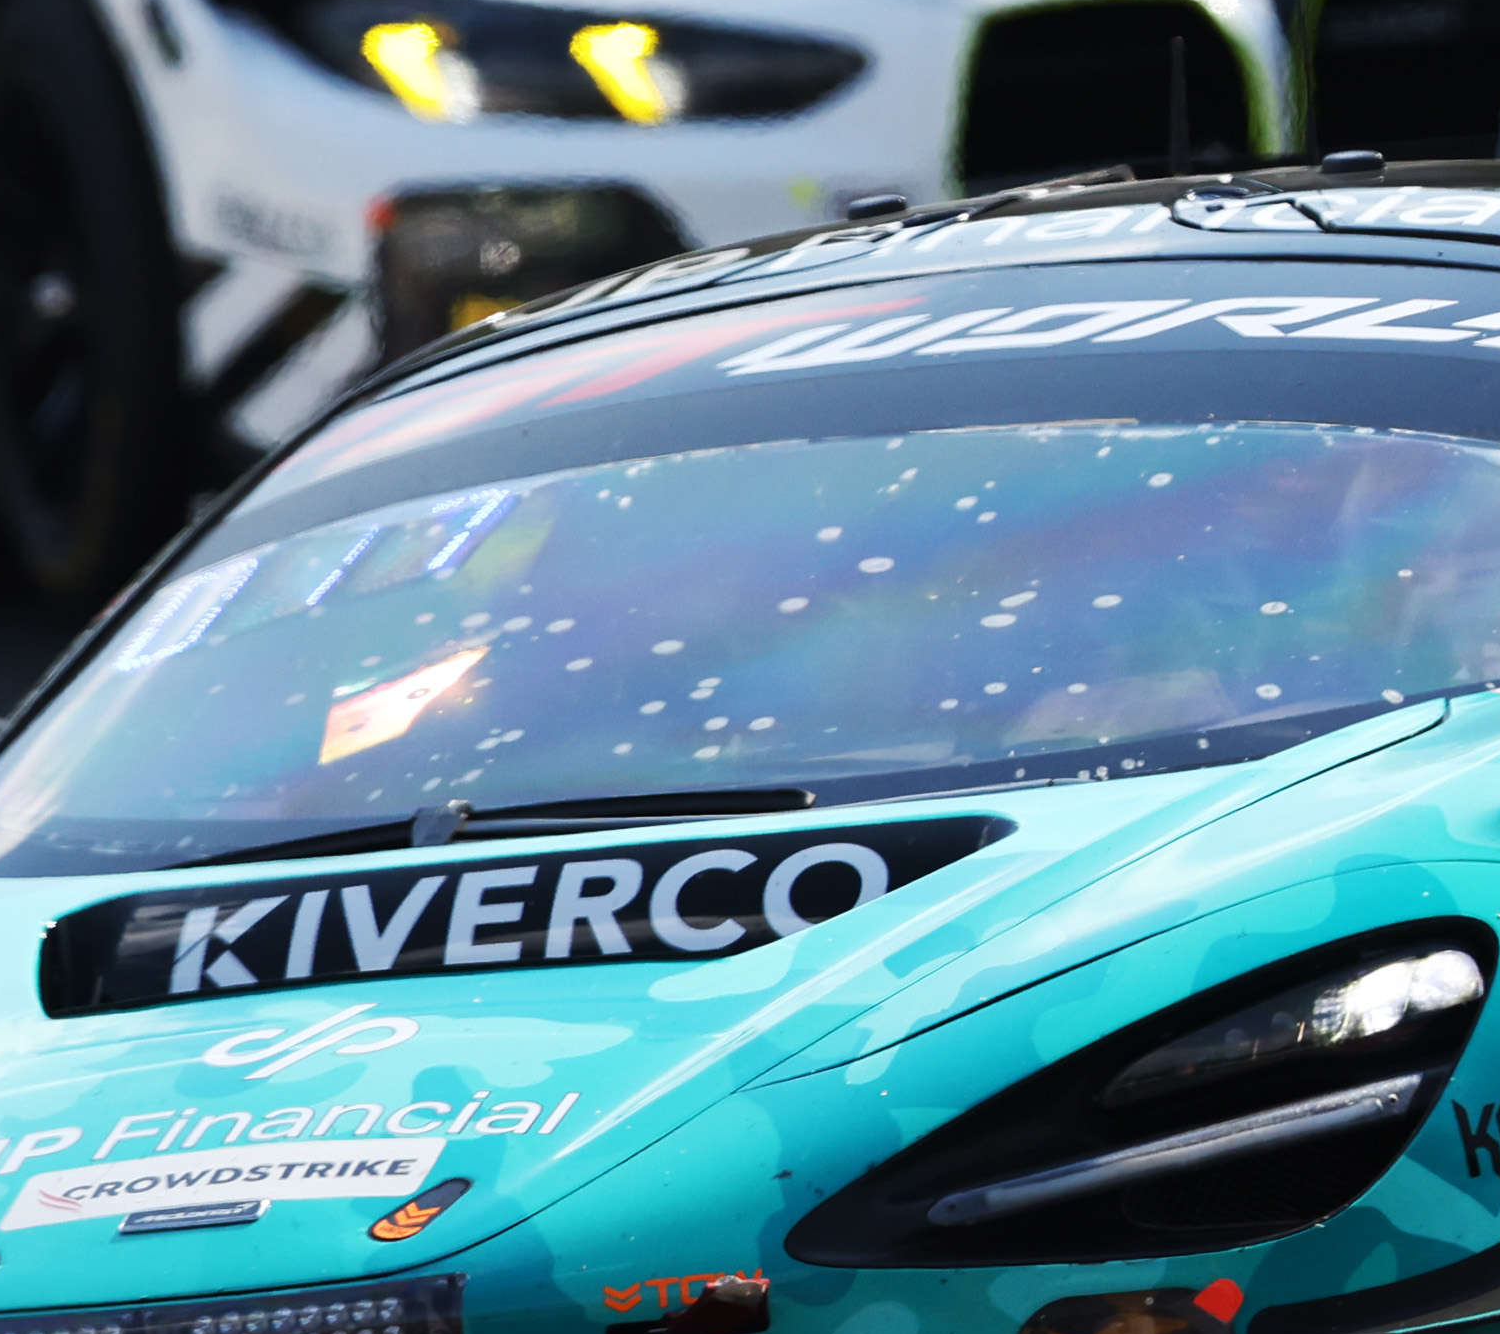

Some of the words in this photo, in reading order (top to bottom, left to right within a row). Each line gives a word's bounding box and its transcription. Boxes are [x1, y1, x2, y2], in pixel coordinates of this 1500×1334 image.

[168, 842, 892, 994] KIVERCO
[92, 1091, 581, 1161] Financial
[62, 1157, 417, 1202] CROWDSTRIKE
